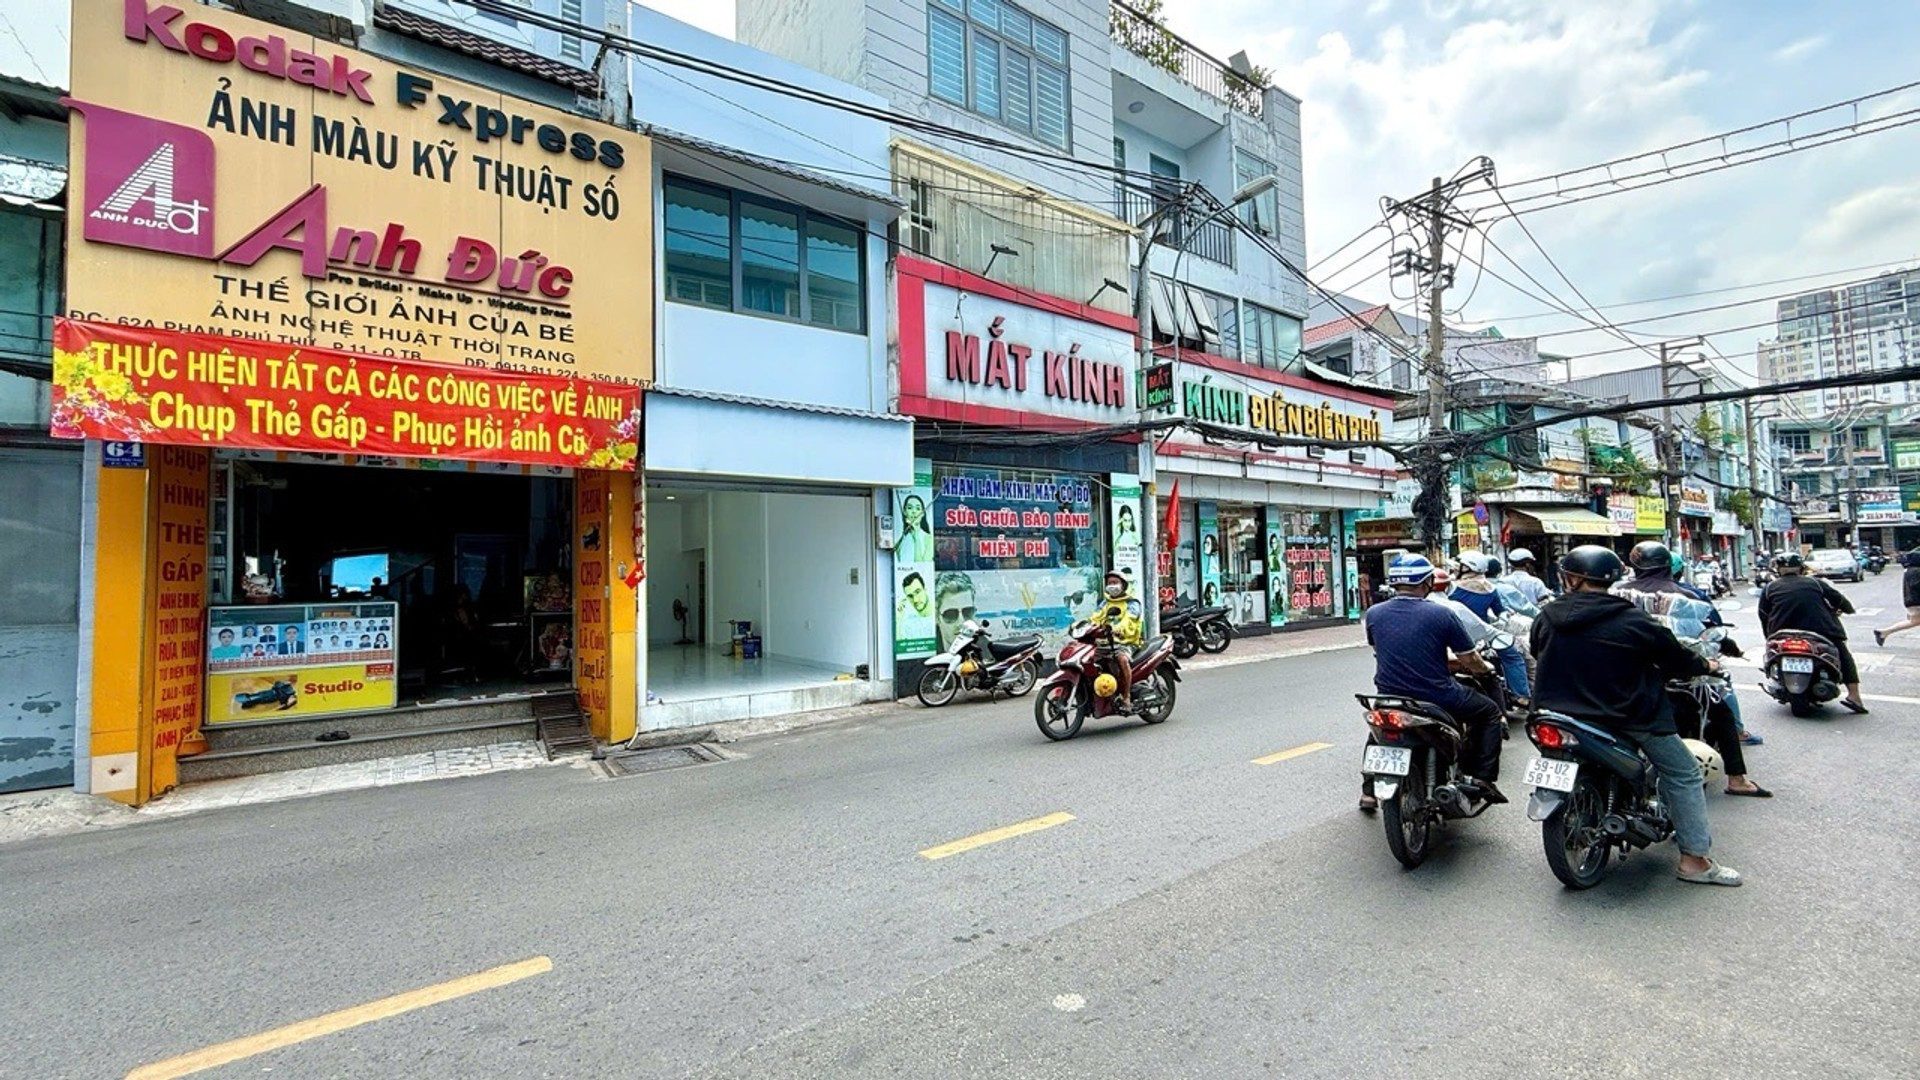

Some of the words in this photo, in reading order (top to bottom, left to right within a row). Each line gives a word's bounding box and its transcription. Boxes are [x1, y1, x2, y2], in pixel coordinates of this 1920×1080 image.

[125, 0, 374, 105] Kodak
[207, 77, 295, 147] ẢNH
[313, 115, 398, 169] MÀU
[413, 139, 458, 183] KỸ
[472, 155, 572, 214] THUẬT
[583, 175, 619, 221] SỐ
[90, 210, 129, 224] ANH
[133, 217, 168, 230] DUC
[214, 183, 422, 279] Anh
[444, 235, 574, 298] Đức
[328, 272, 353, 285] Pro
[418, 286, 453, 300] Make
[456, 293, 473, 305] Up
[214, 276, 290, 303] THẾ
[305, 289, 377, 317] GIỚI
[389, 296, 457, 327] ẢNH
[468, 304, 529, 337] CỦA
[540, 324, 575, 343] BÉ
[210, 300, 269, 325] ẢNH
[280, 313, 353, 336] NGHỆ
[364, 325, 442, 348] THUẬT
[450, 334, 499, 355] THỜI
[507, 344, 576, 364] TRANG
[946, 315, 1032, 391] MẮT
[1044, 343, 1125, 408] KÍNH
[91, 341, 178, 386] THỰC
[188, 349, 257, 393] HIỆN
[266, 350, 318, 392] TẤT
[325, 359, 361, 396] CẢ
[369, 366, 420, 402] CÁC
[427, 374, 490, 409] CÔNG
[497, 382, 545, 419] VIỆC
[551, 381, 577, 417] VỀ
[583, 385, 622, 421] ẢNH
[1183, 375, 1244, 426] KÍNH
[1249, 390, 1300, 436] ĐIỆN
[150, 391, 236, 440] Chụp
[246, 400, 301, 435] Thẻ
[312, 401, 366, 447] Gấp
[393, 411, 456, 454] Phục
[465, 414, 503, 449] Hồi
[511, 419, 551, 453] ảnh
[558, 424, 588, 455] Cũ
[106, 442, 142, 458] 64
[163, 446, 207, 476] CHỤP
[163, 480, 205, 508] HÌNH
[162, 518, 205, 545] THẺ
[946, 504, 977, 527] SỬA
[980, 507, 1019, 527] CHỮA
[1022, 506, 1050, 528] BẢO
[1054, 509, 1090, 528] HÀNH
[979, 534, 1017, 557] MIỄN
[1024, 537, 1049, 557] PHÍ
[162, 553, 203, 582] GẤP
[304, 679, 364, 695] Studio
[1372, 748, 1403, 762] 59-S2
[1534, 760, 1570, 776] 59-U2
